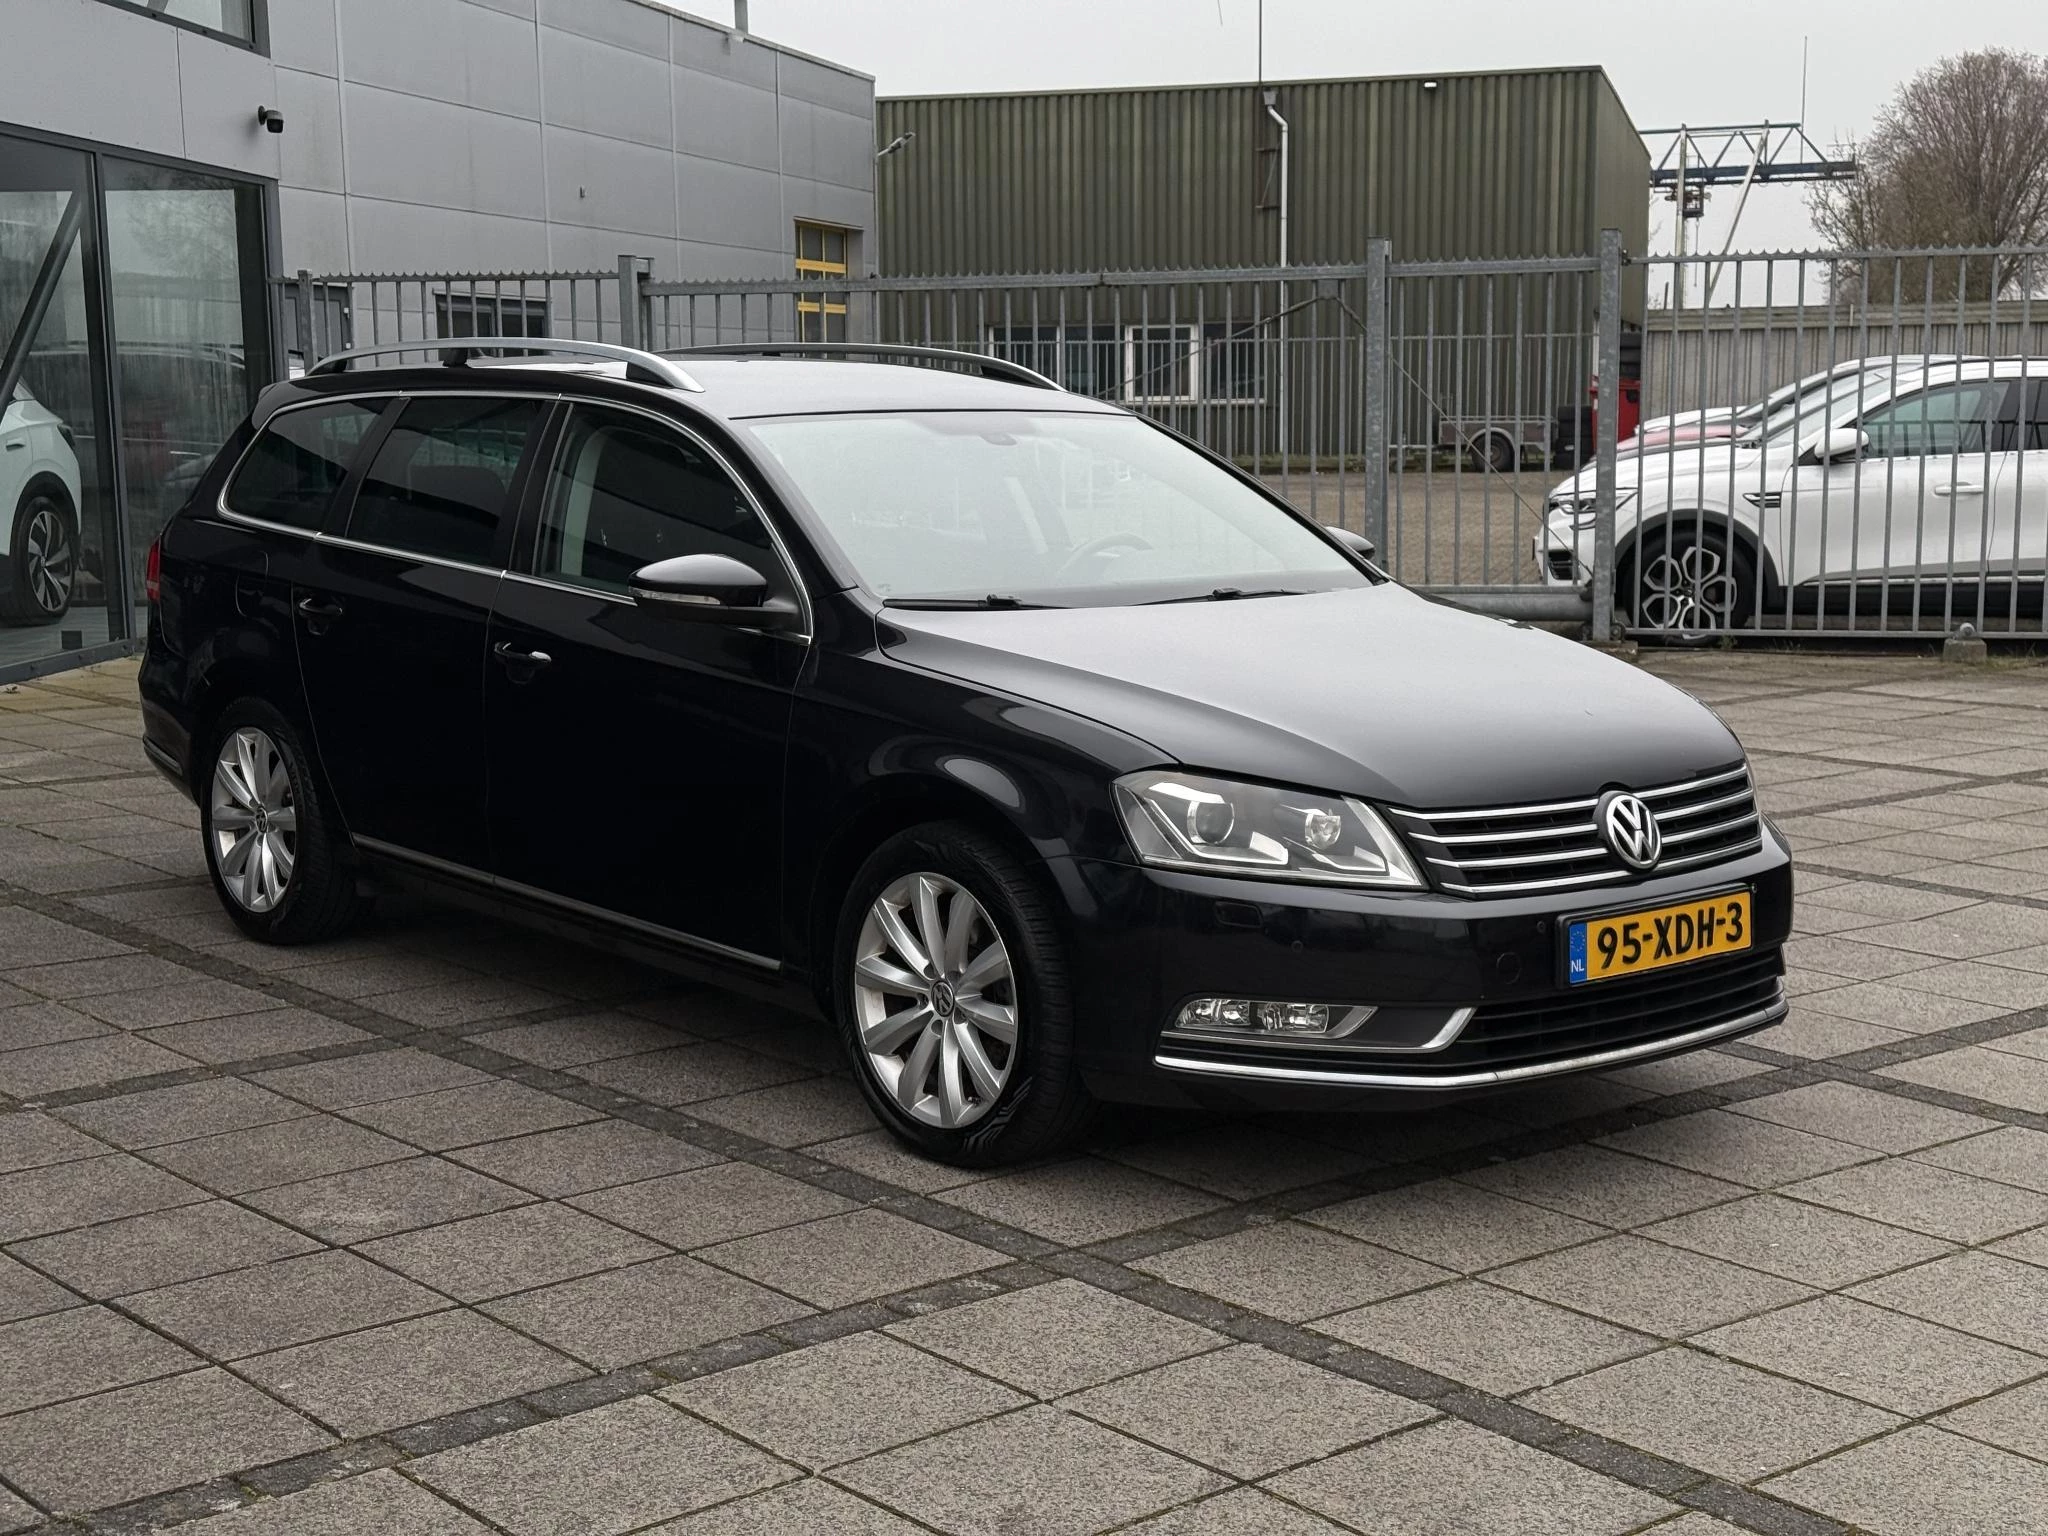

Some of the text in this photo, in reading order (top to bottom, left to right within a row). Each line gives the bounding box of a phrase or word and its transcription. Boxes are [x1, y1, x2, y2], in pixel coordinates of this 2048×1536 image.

[1607, 795, 1660, 867] VW
[1571, 959, 1584, 973] NL
[1597, 902, 1743, 969] 95-XDH-3
